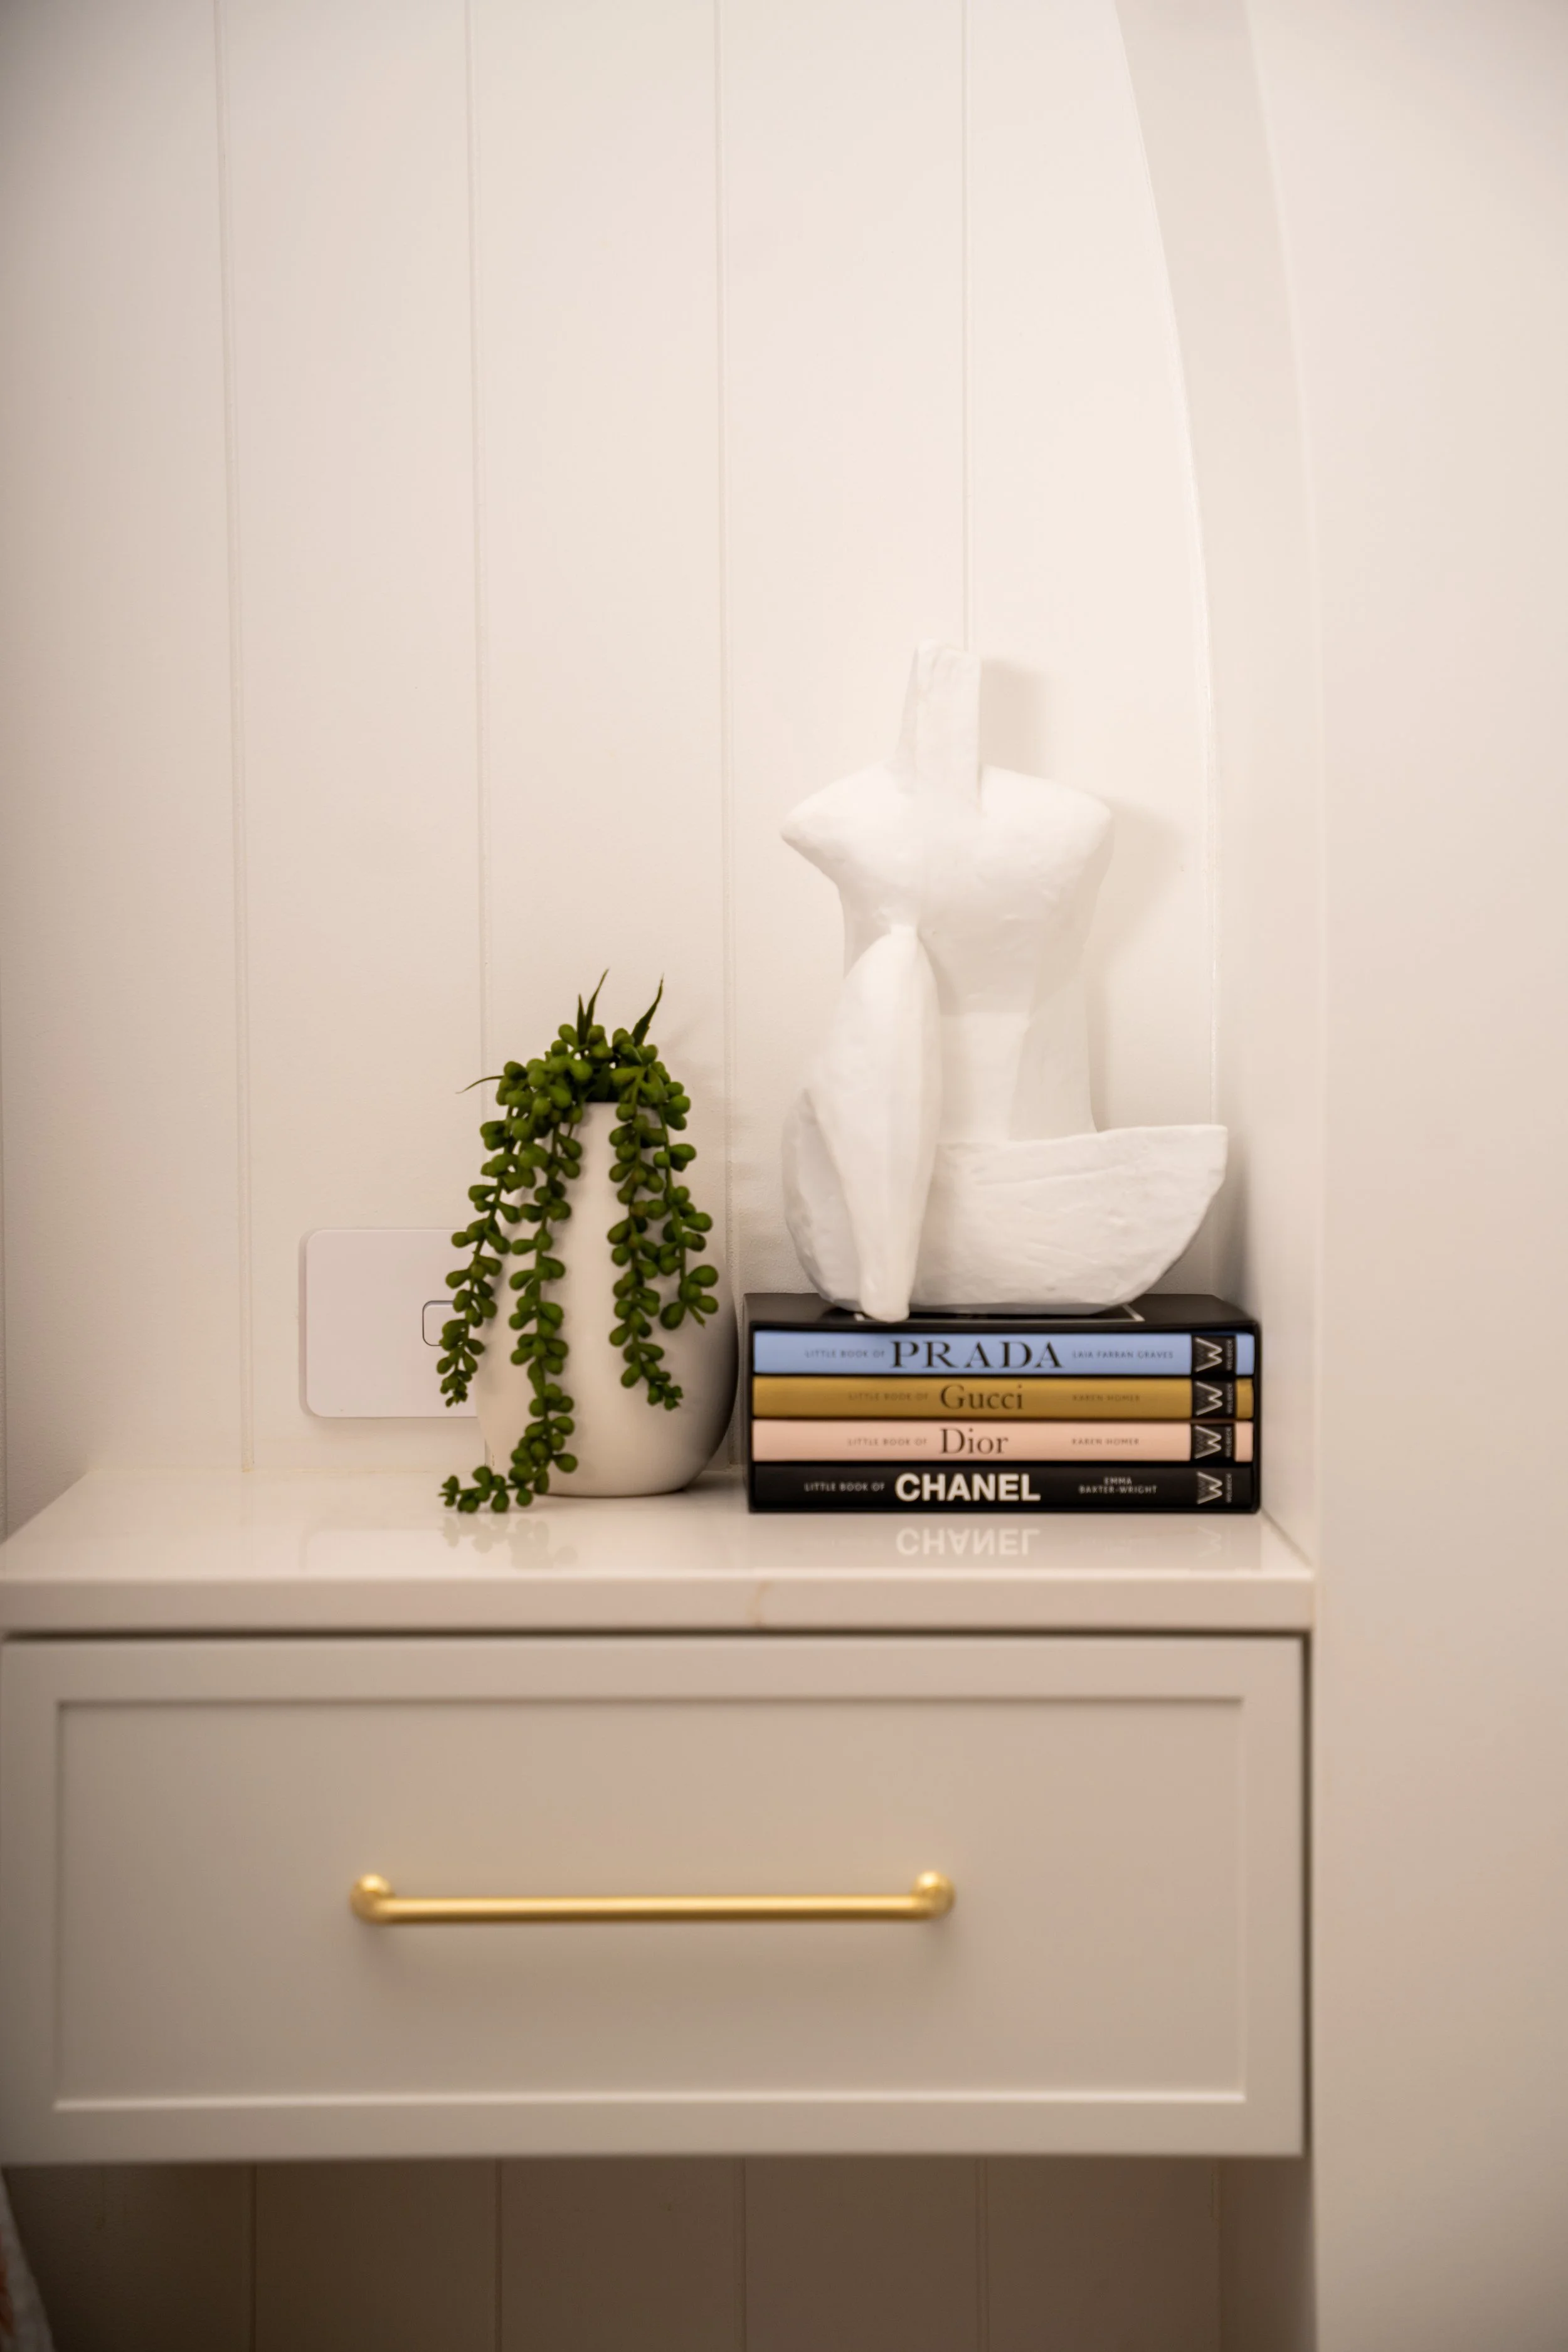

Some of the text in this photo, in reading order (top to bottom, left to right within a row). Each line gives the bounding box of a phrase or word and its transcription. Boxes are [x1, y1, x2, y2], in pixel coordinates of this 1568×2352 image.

[804, 1340, 1063, 1369] LITTLE BOOK OF PRADA
[1072, 1350, 1173, 1359] LAIA FARRAN GRAVES
[848, 1384, 1024, 1410] LITTLE BOOK OF Gucci
[1072, 1394, 1140, 1402] KAREN HOMER
[847, 1428, 1009, 1455] LITTLE BOOK OF Dior
[1071, 1438, 1140, 1446] KAREN HOMER
[1103, 1476, 1133, 1485] EMMA
[803, 1472, 1041, 1502] LITTLE BOOK OF CHANEL
[1078, 1485, 1158, 1495] BAXTER-WRIGHT
